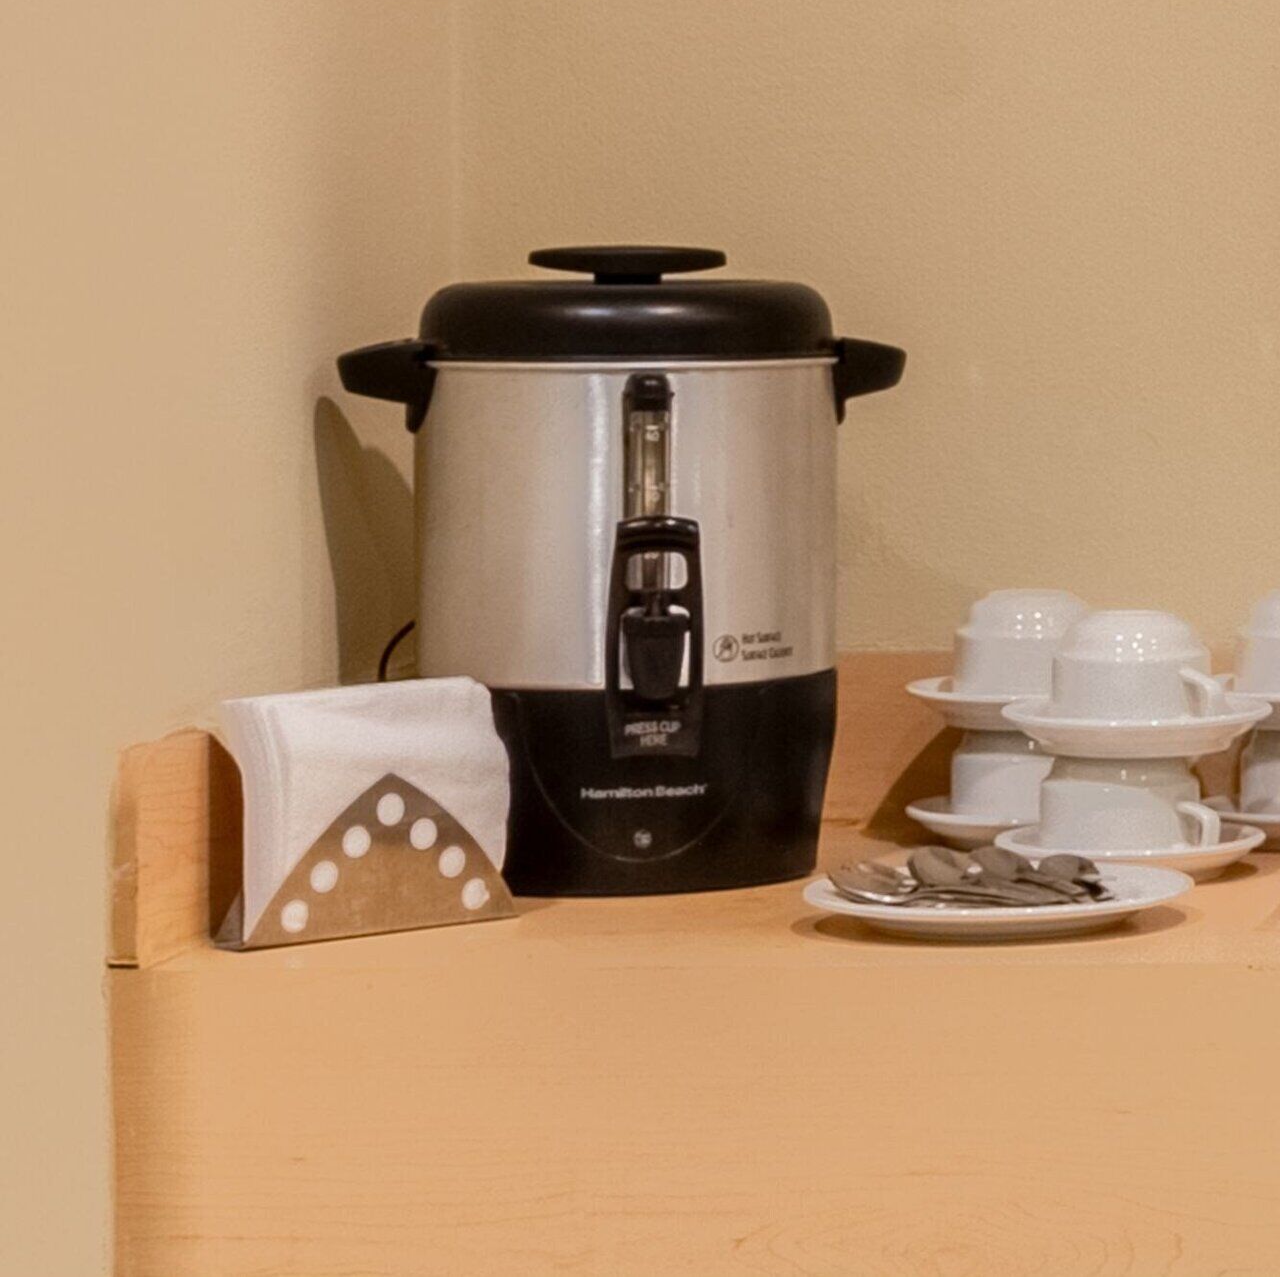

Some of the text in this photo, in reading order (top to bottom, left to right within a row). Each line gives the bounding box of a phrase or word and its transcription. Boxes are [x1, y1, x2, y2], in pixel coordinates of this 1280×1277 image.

[624, 719, 682, 737] PRESS CUP
[640, 733, 667, 748] HERE
[580, 784, 705, 800] Hamilton Beach
